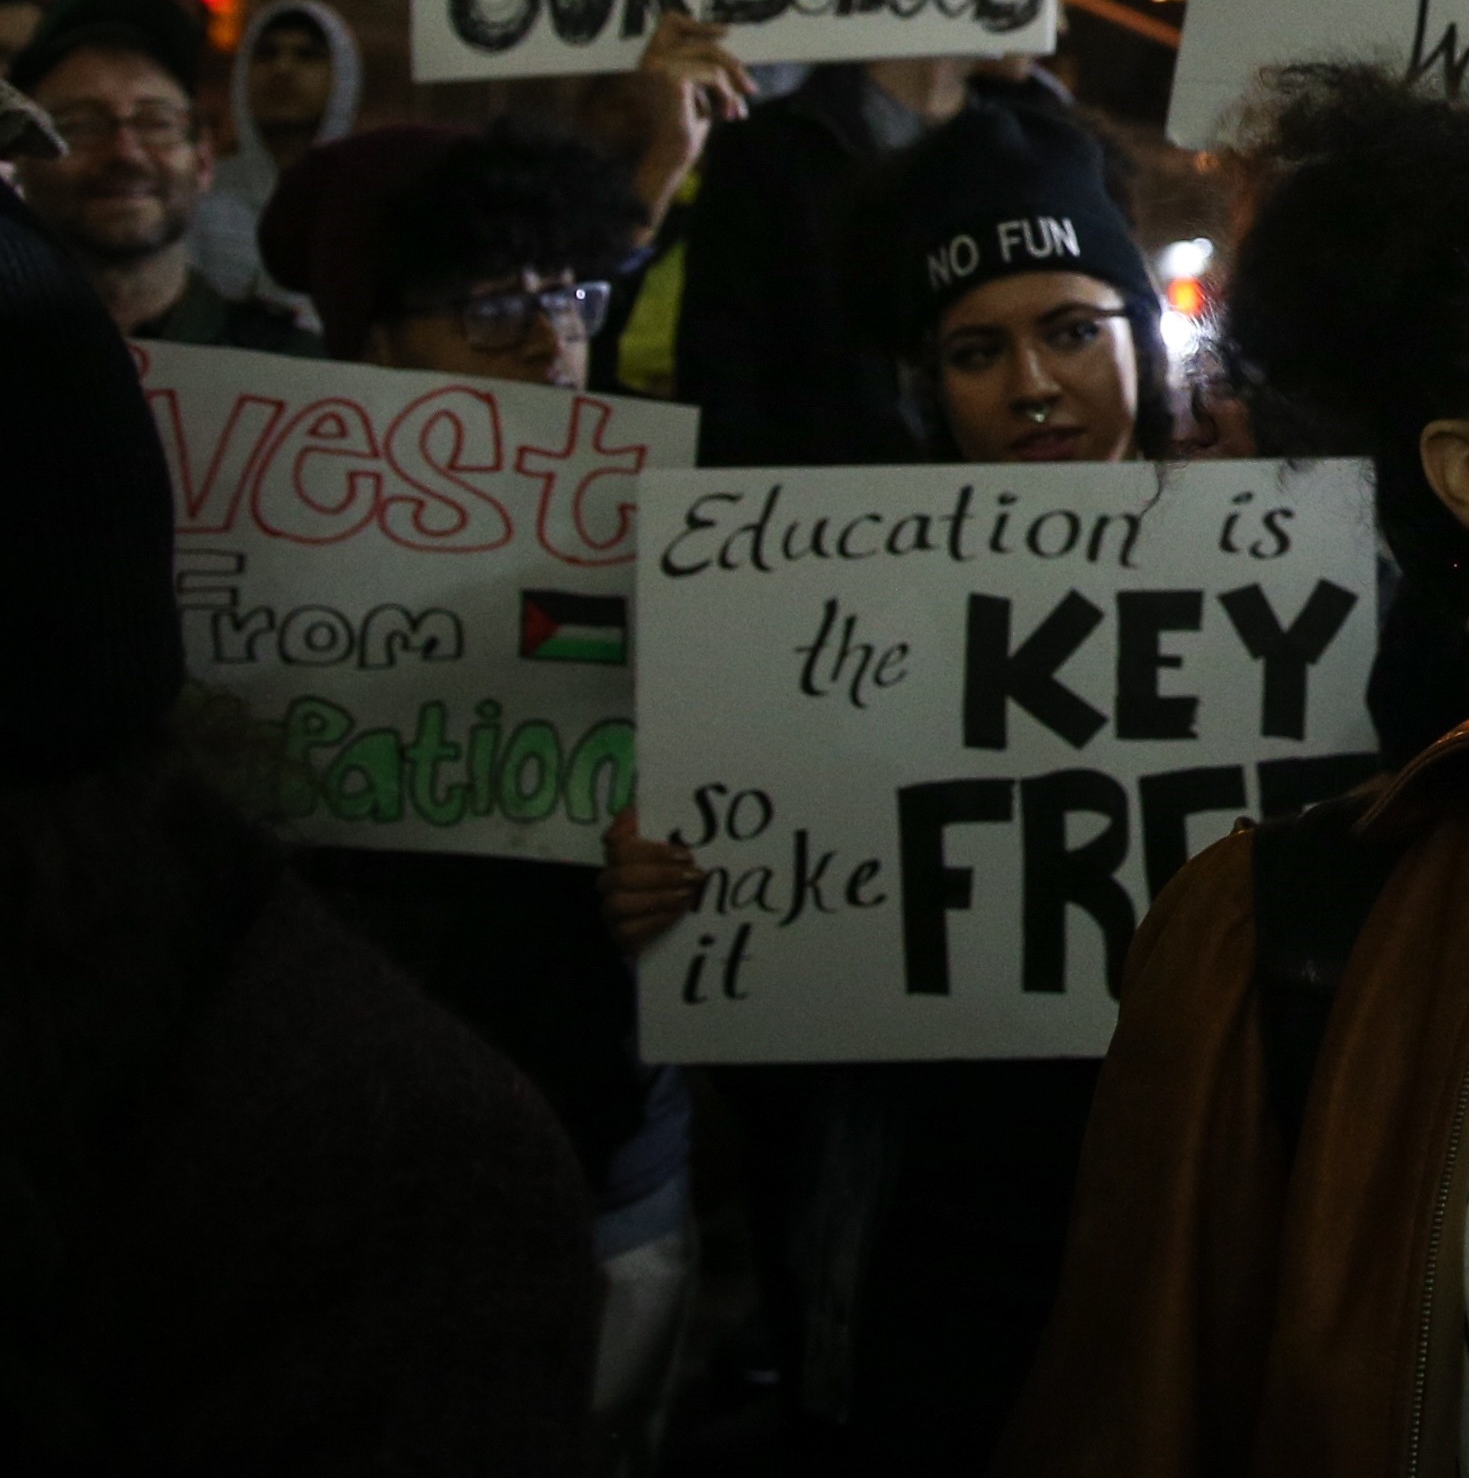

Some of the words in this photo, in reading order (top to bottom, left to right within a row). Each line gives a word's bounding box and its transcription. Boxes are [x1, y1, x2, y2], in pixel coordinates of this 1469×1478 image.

[926, 233, 980, 291] NO
[997, 216, 1082, 263] FUN
[147, 384, 647, 567] vest
[659, 482, 1145, 579] Education
[1219, 490, 1296, 559] is
[793, 597, 911, 710] the
[962, 577, 1361, 751] KEY
[668, 780, 773, 847] so
[683, 922, 751, 995] it
